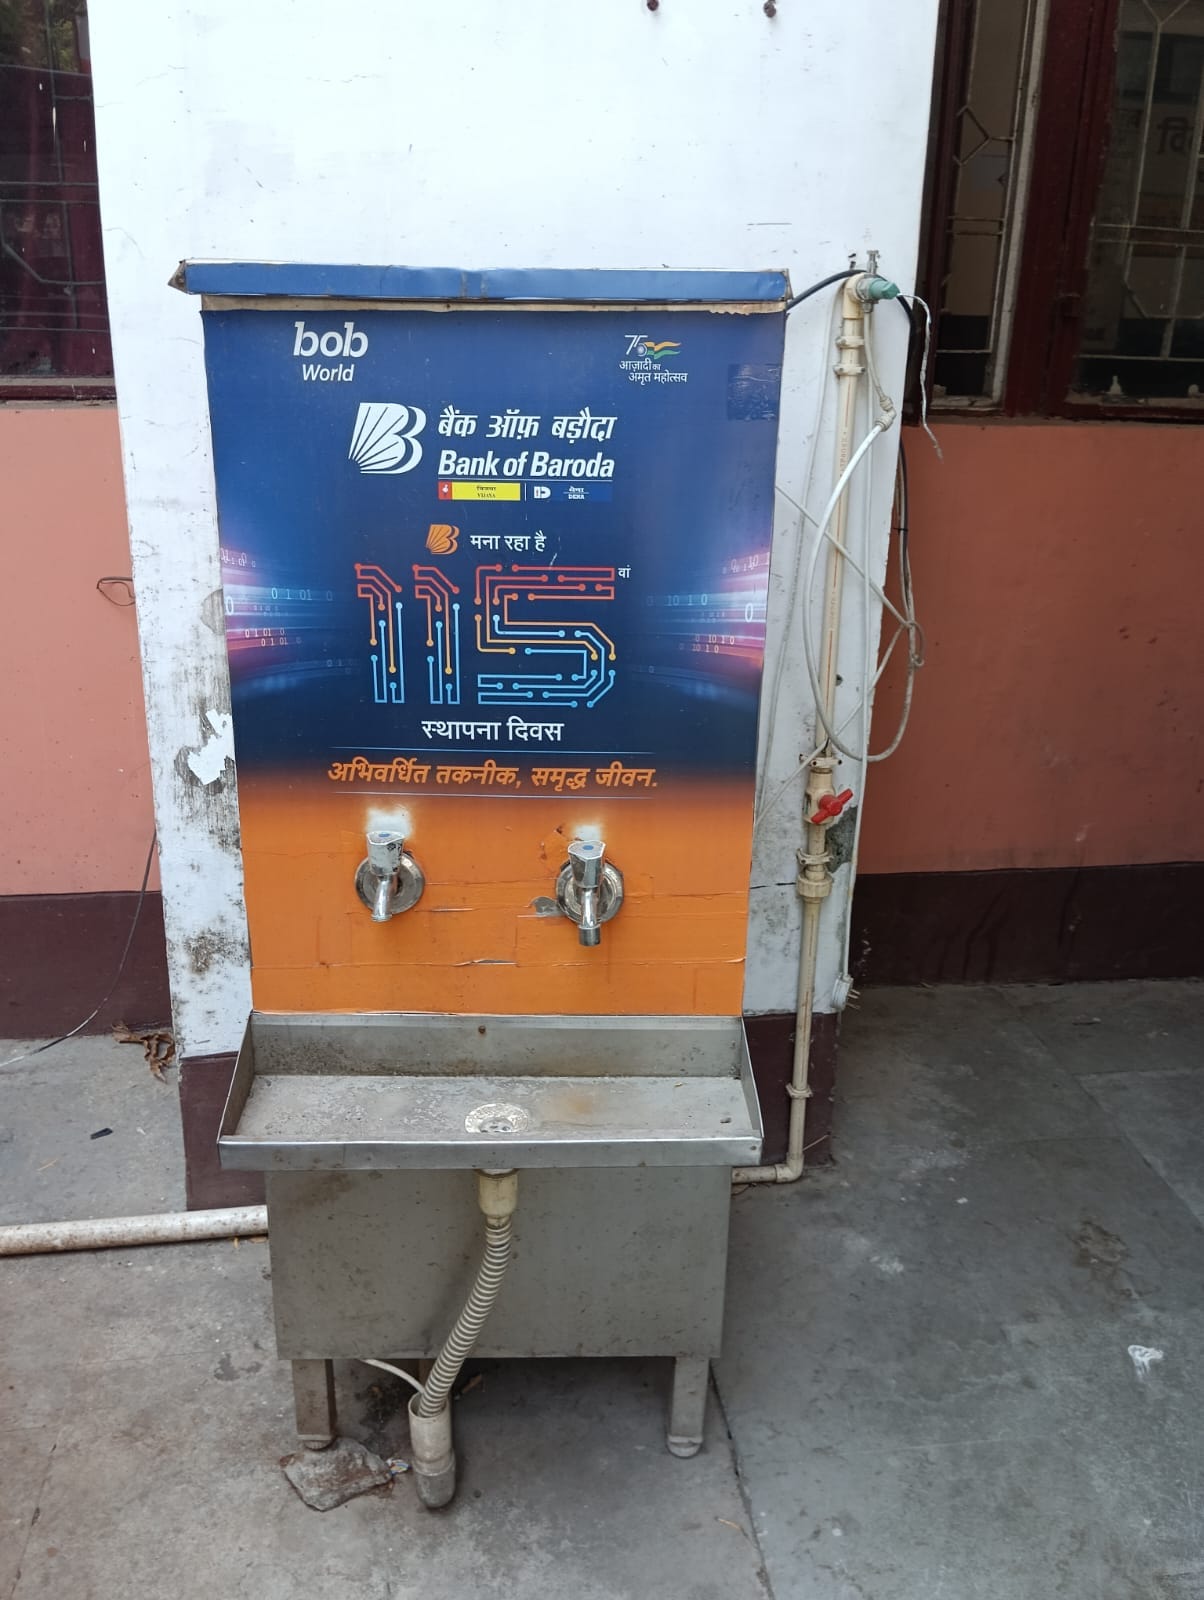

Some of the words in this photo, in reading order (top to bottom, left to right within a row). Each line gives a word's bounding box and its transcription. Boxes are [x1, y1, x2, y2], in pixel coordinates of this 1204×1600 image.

[293, 321, 369, 358] bob
[302, 363, 355, 382] World
[628, 371, 651, 385] अमृत
[654, 369, 688, 384] महोत्सव
[652, 363, 661, 371] का
[438, 404, 478, 438] बैंक
[485, 408, 541, 440] ऑफ़
[551, 406, 618, 444] बड़ौदा
[438, 449, 500, 476] Bank
[503, 451, 529, 477] of
[530, 450, 615, 478] Baroda
[470, 534, 500, 550] मना
[504, 534, 531, 552] रहा
[534, 530, 547, 552] है
[354, 563, 615, 708] 115
[618, 564, 631, 579] वां
[421, 719, 501, 740] स्थापना
[506, 715, 565, 742] दिवस
[328, 756, 431, 784] अभिवर्धित
[436, 759, 523, 789] तकनीक,
[531, 767, 590, 792] समृद्ध
[595, 761, 658, 788] जीवन.
